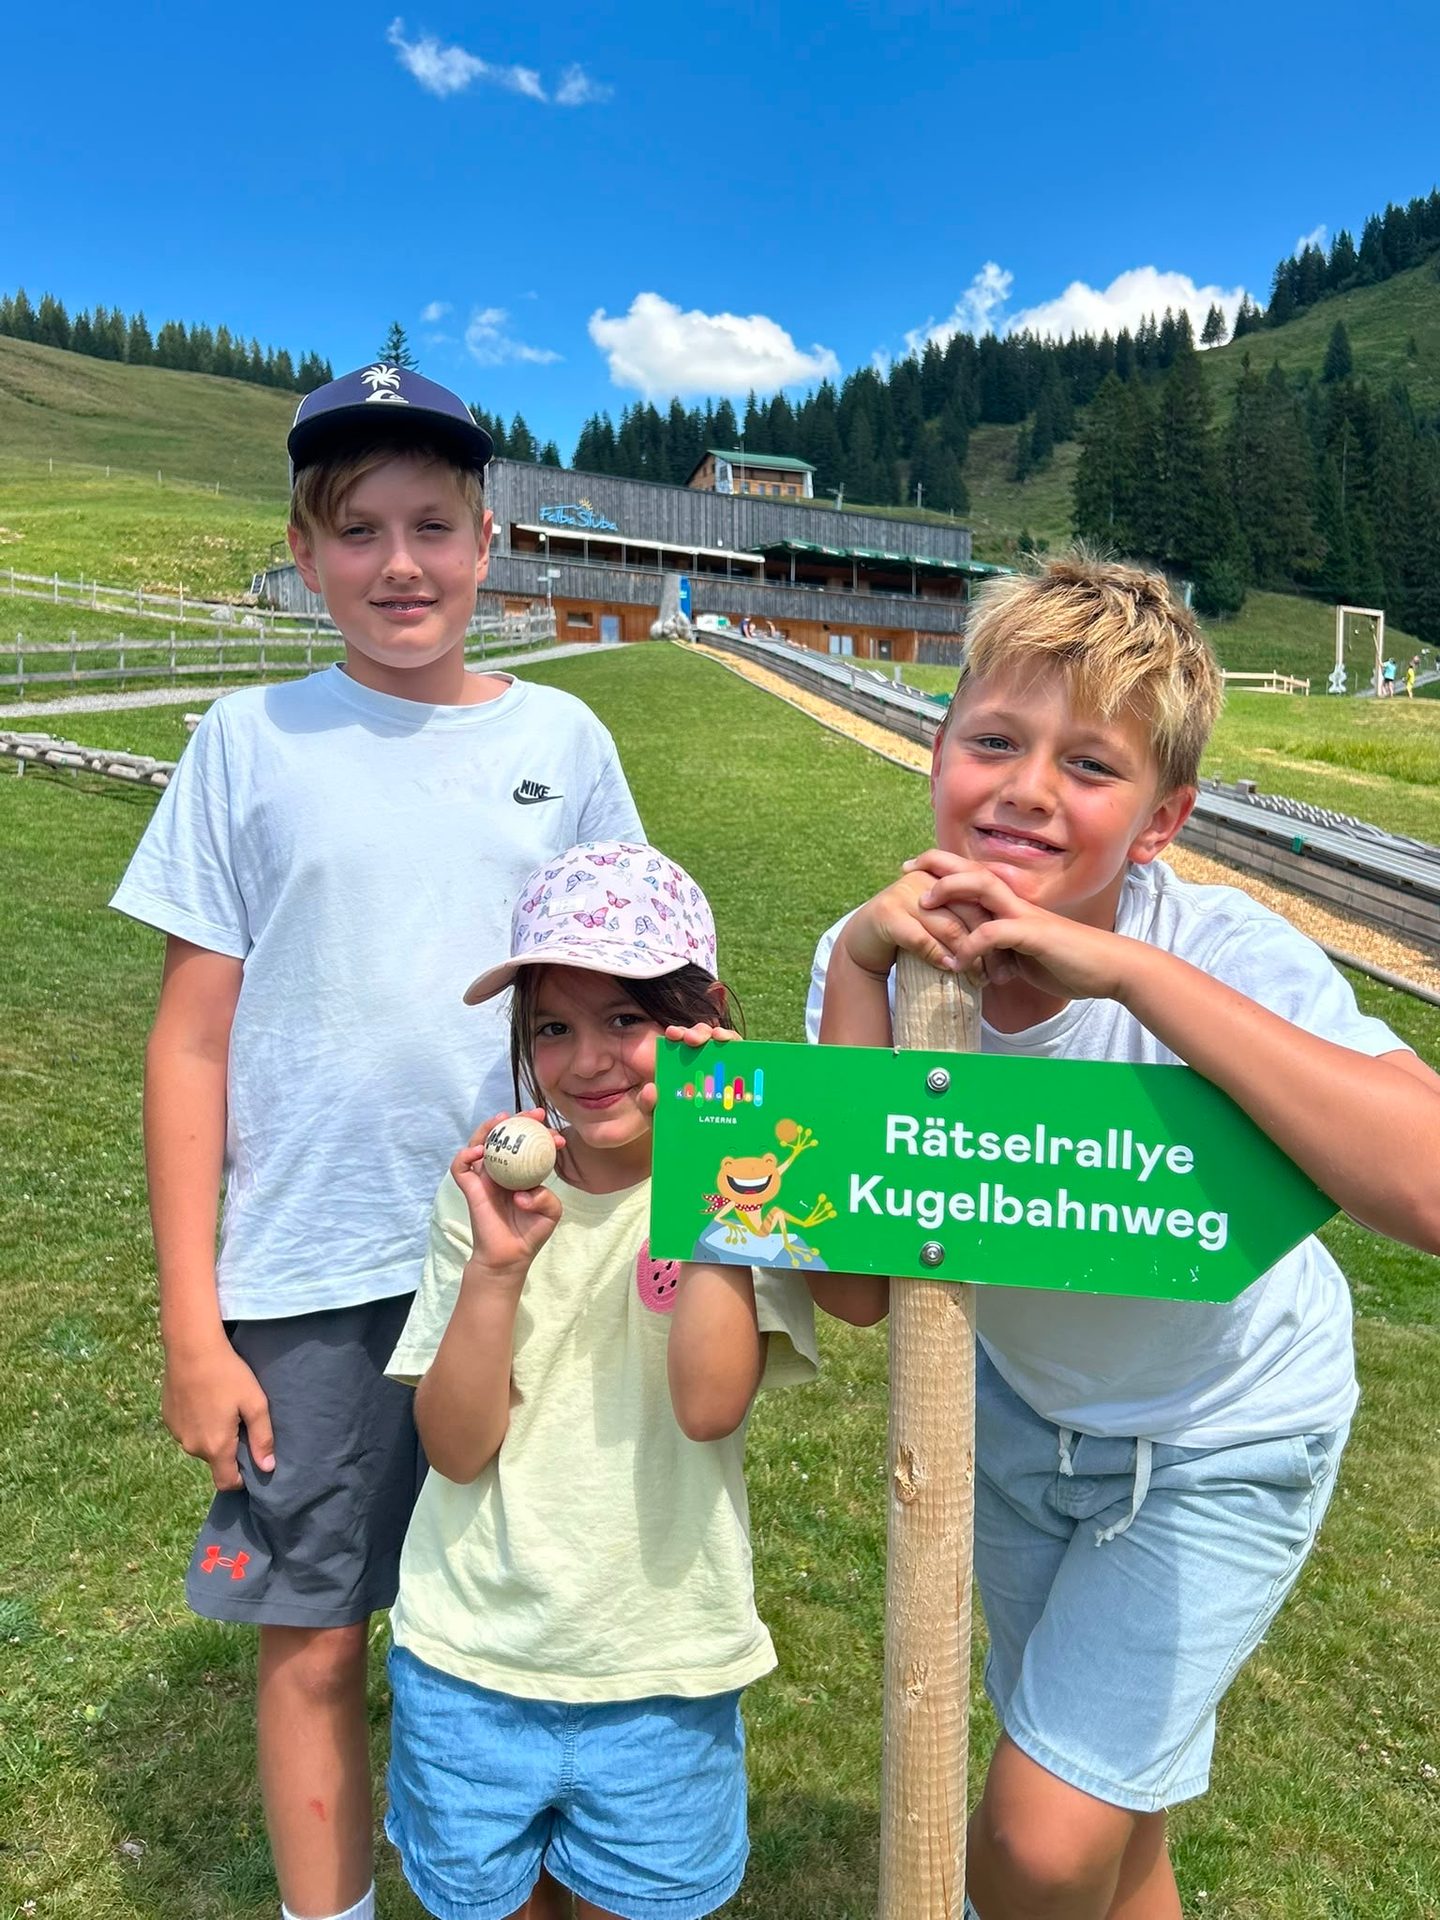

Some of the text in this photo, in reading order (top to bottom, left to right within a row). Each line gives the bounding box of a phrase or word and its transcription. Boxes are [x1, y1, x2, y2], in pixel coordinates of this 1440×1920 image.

[520, 779, 551, 799] NIKE
[699, 1116, 737, 1124] LATERNS
[886, 1114, 1194, 1182] Rätselrallye
[849, 1173, 1229, 1251] Kugelbahnweg
